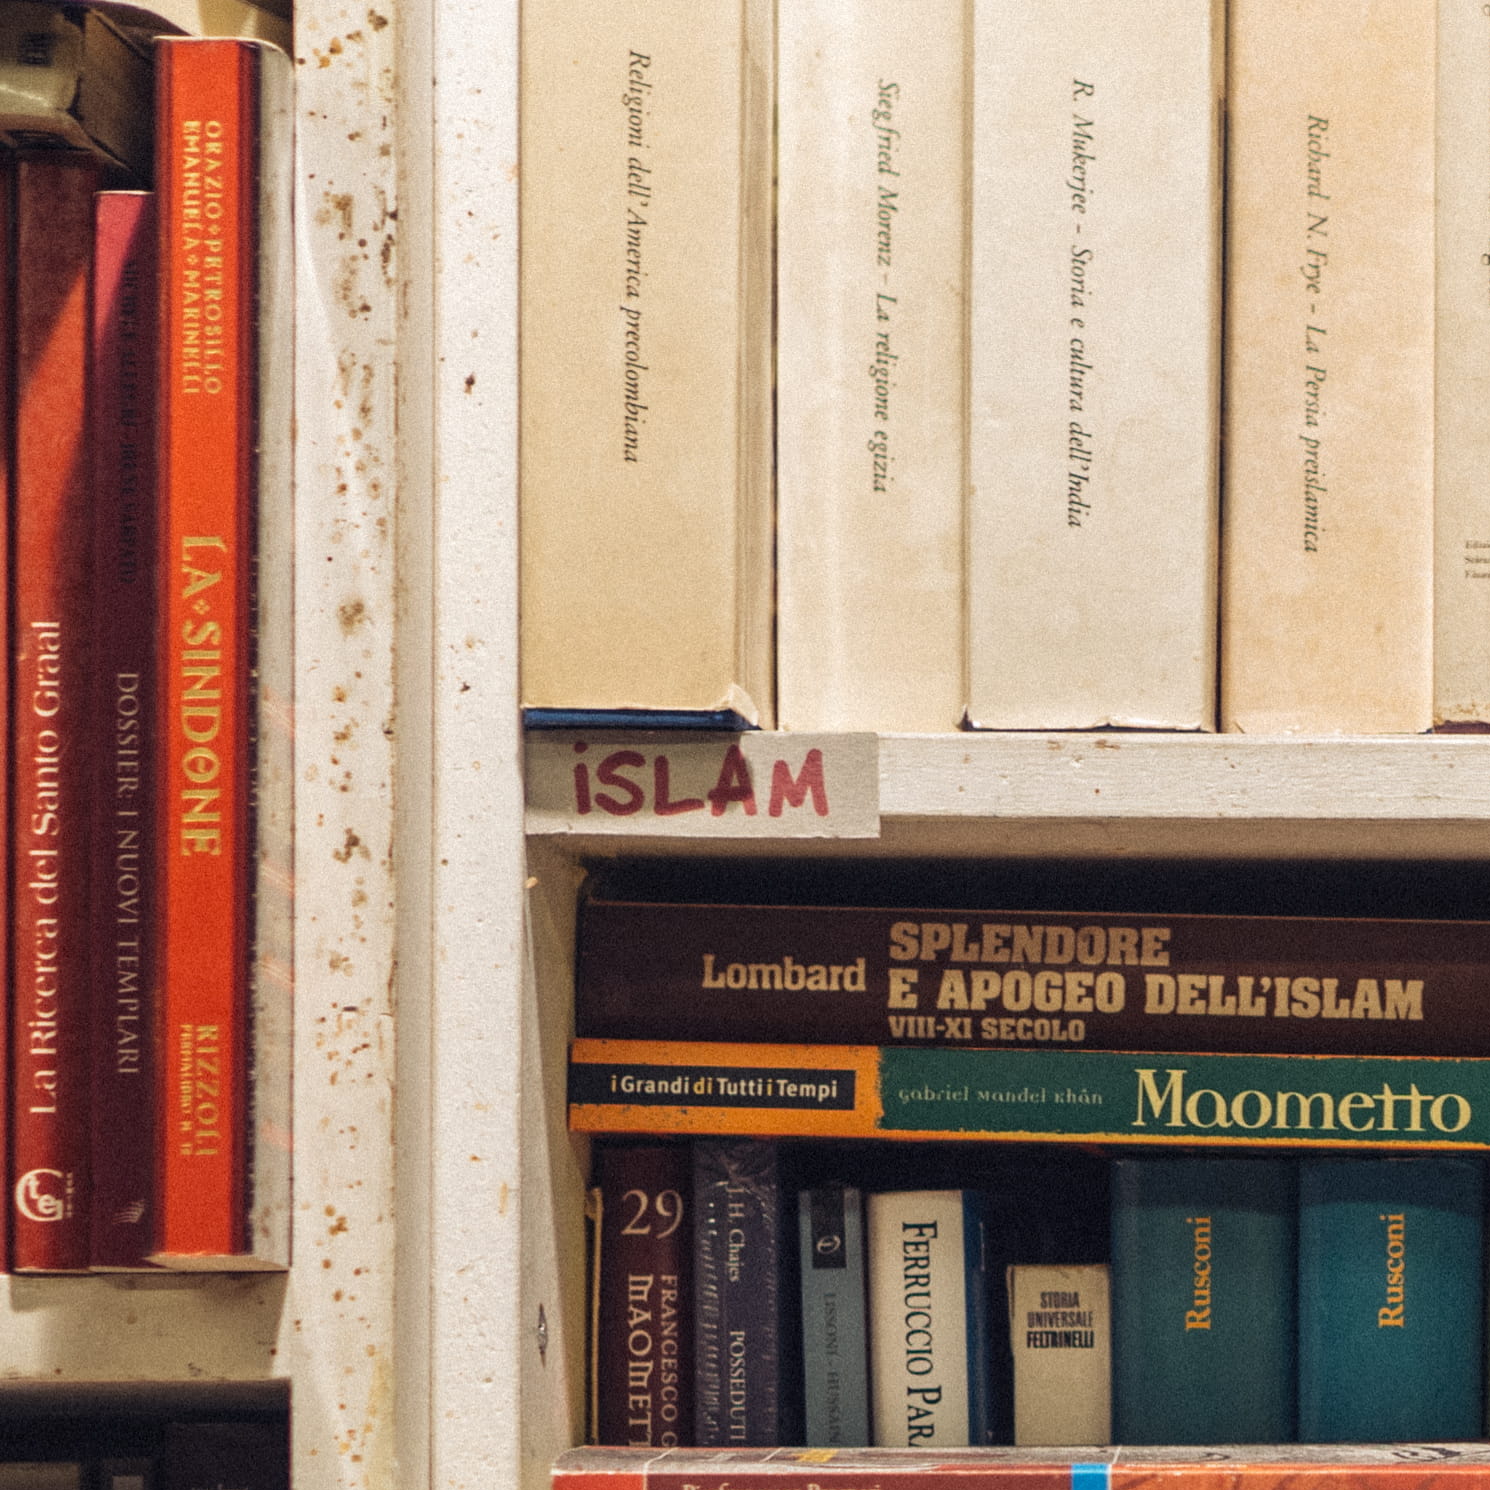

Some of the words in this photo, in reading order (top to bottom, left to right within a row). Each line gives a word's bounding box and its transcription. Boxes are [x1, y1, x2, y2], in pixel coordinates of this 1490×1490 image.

[622, 50, 652, 147] Religioni
[626, 157, 651, 298] dell'America
[620, 306, 649, 462] precolombiana
[182, 537, 227, 598] LA
[31, 621, 58, 717] Graal
[182, 621, 221, 855] SINDONE
[31, 729, 60, 836] Santo
[28, 849, 58, 905] del
[702, 955, 866, 992] Lombard
[891, 924, 1169, 966] SPLENDORE
[28, 918, 58, 1057] Ricerca
[889, 969, 917, 1008] E
[938, 972, 1124, 1011] APOGEO
[1146, 974, 1423, 1019] DELL'ISLAM
[889, 1016, 971, 1038] VIII-XI
[982, 1018, 1084, 1040] SECOLO
[29, 1069, 57, 1114] La
[1133, 1069, 1471, 1132] Maometto
[1186, 1218, 1211, 1330] Rusconi
